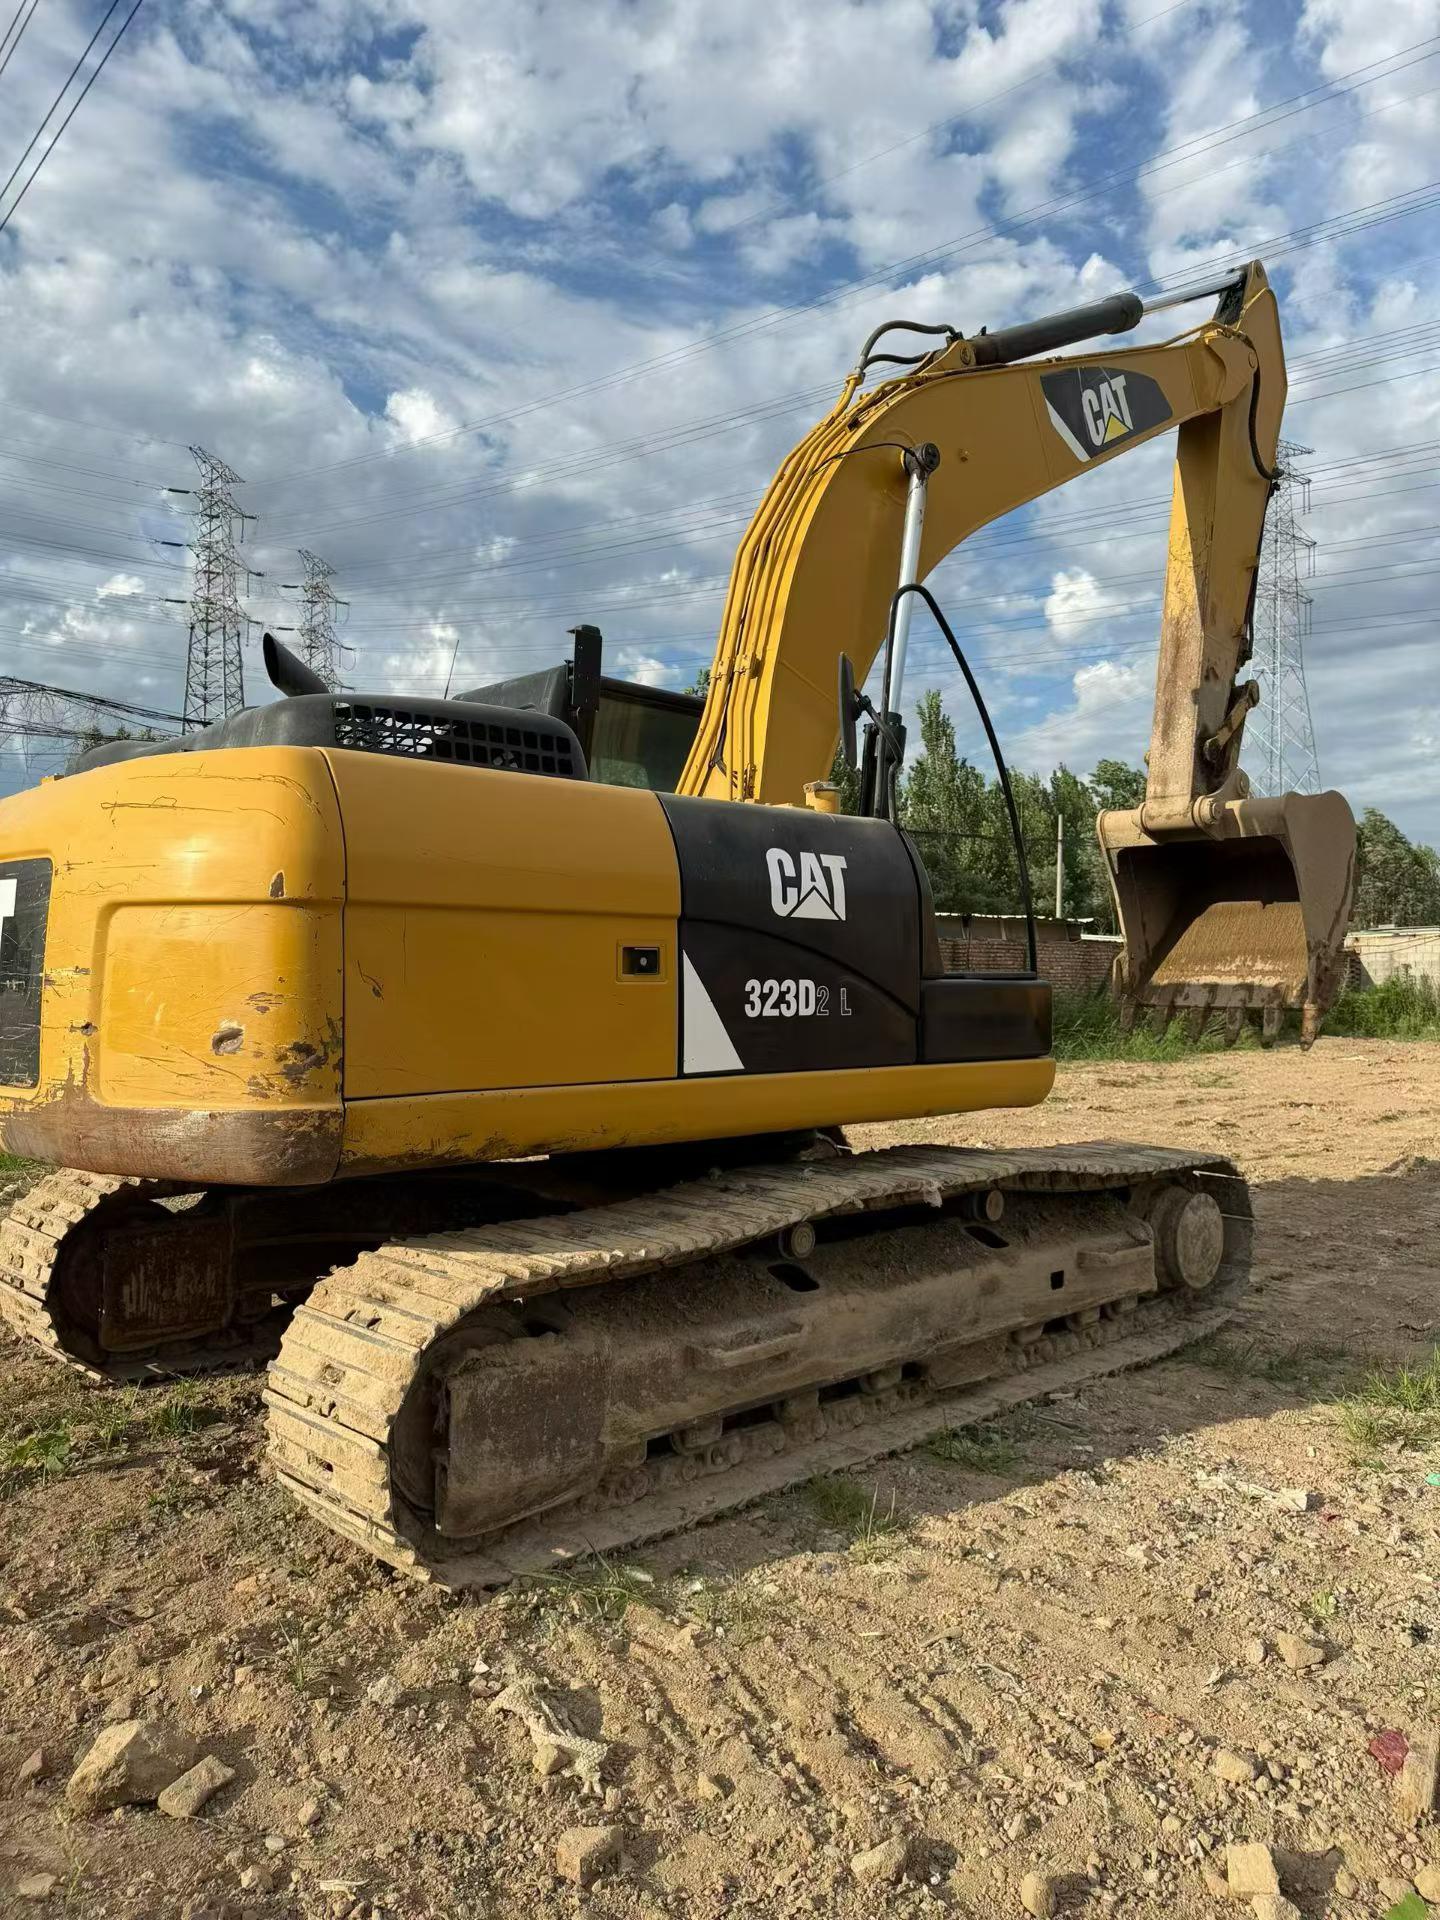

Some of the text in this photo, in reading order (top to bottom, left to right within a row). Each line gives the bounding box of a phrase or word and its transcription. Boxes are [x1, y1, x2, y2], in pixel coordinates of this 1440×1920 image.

[1082, 375, 1134, 447] CAT
[766, 848, 847, 921] CAT
[744, 979, 852, 1018] 323D2 L
